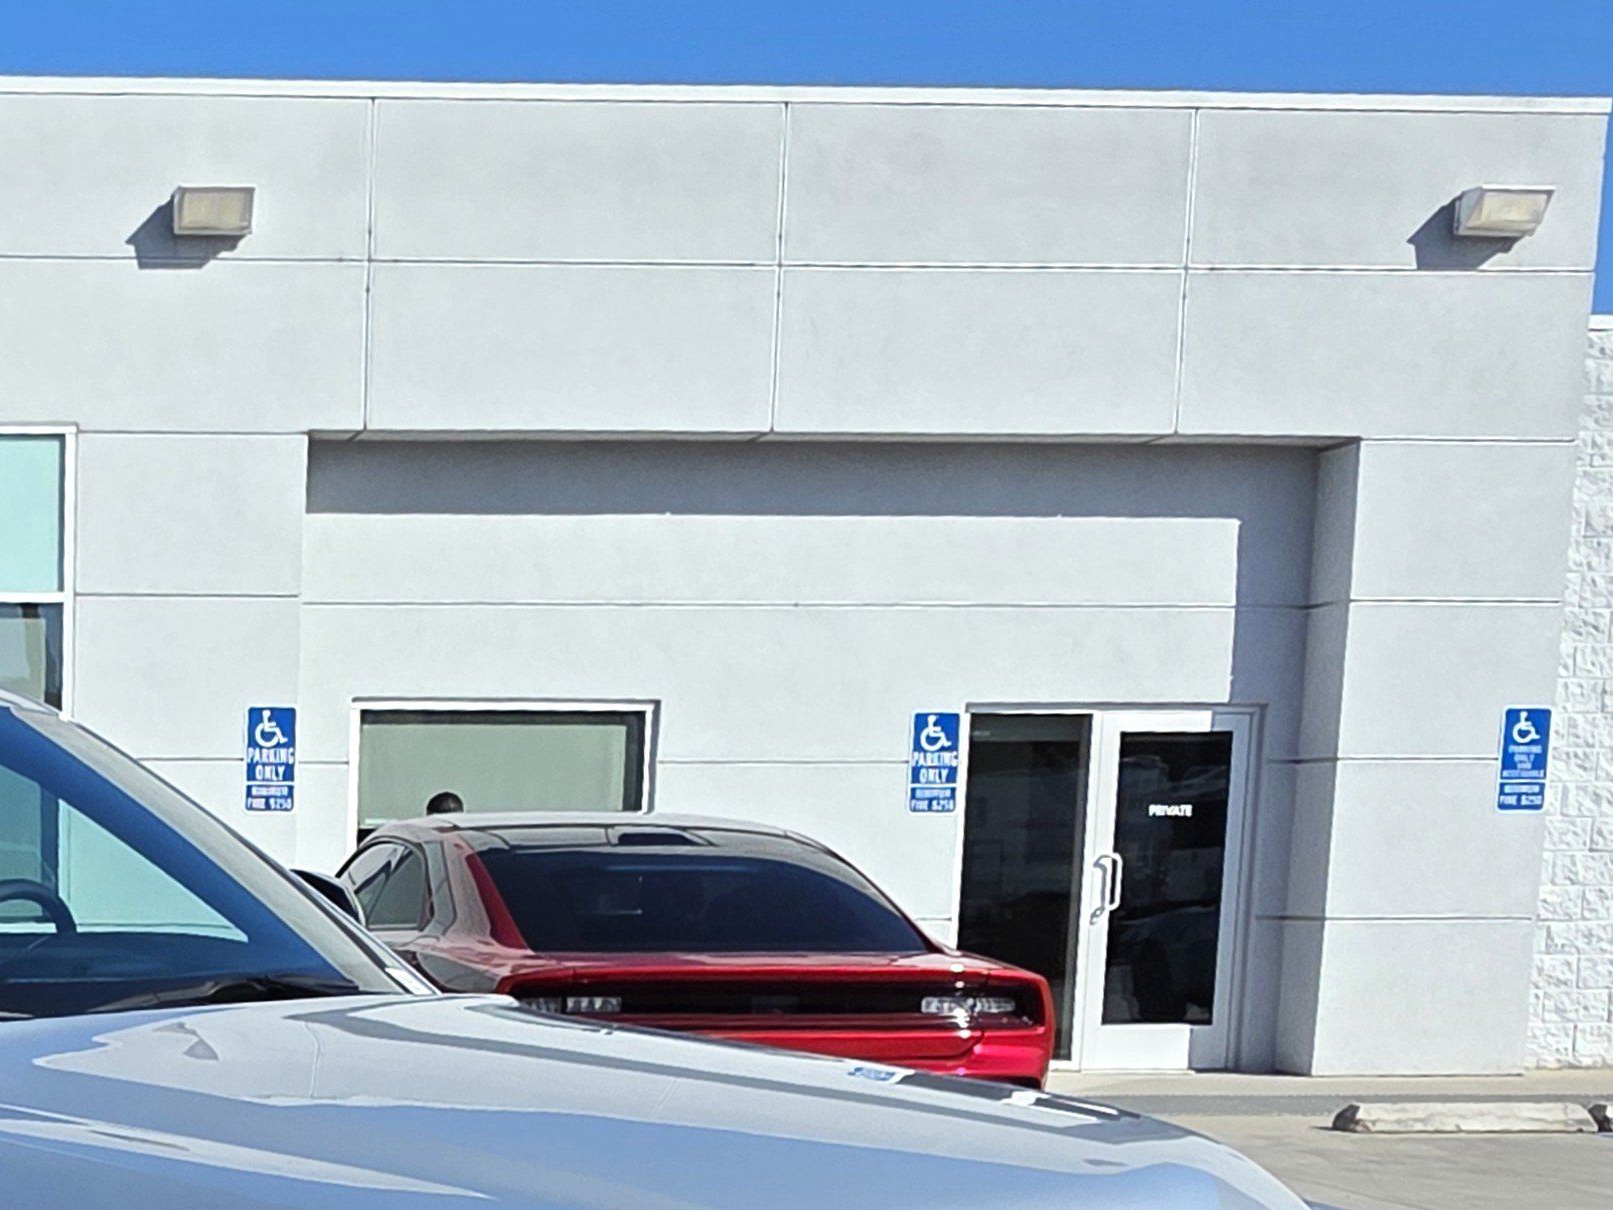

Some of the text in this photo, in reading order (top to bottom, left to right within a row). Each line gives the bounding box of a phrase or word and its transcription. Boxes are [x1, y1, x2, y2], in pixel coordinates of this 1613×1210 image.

[248, 747, 294, 764] PARKING
[912, 751, 958, 767] PARKING
[255, 765, 285, 780] ONLY
[919, 768, 949, 783] ONLY
[1148, 804, 1192, 817] PRIVATE
